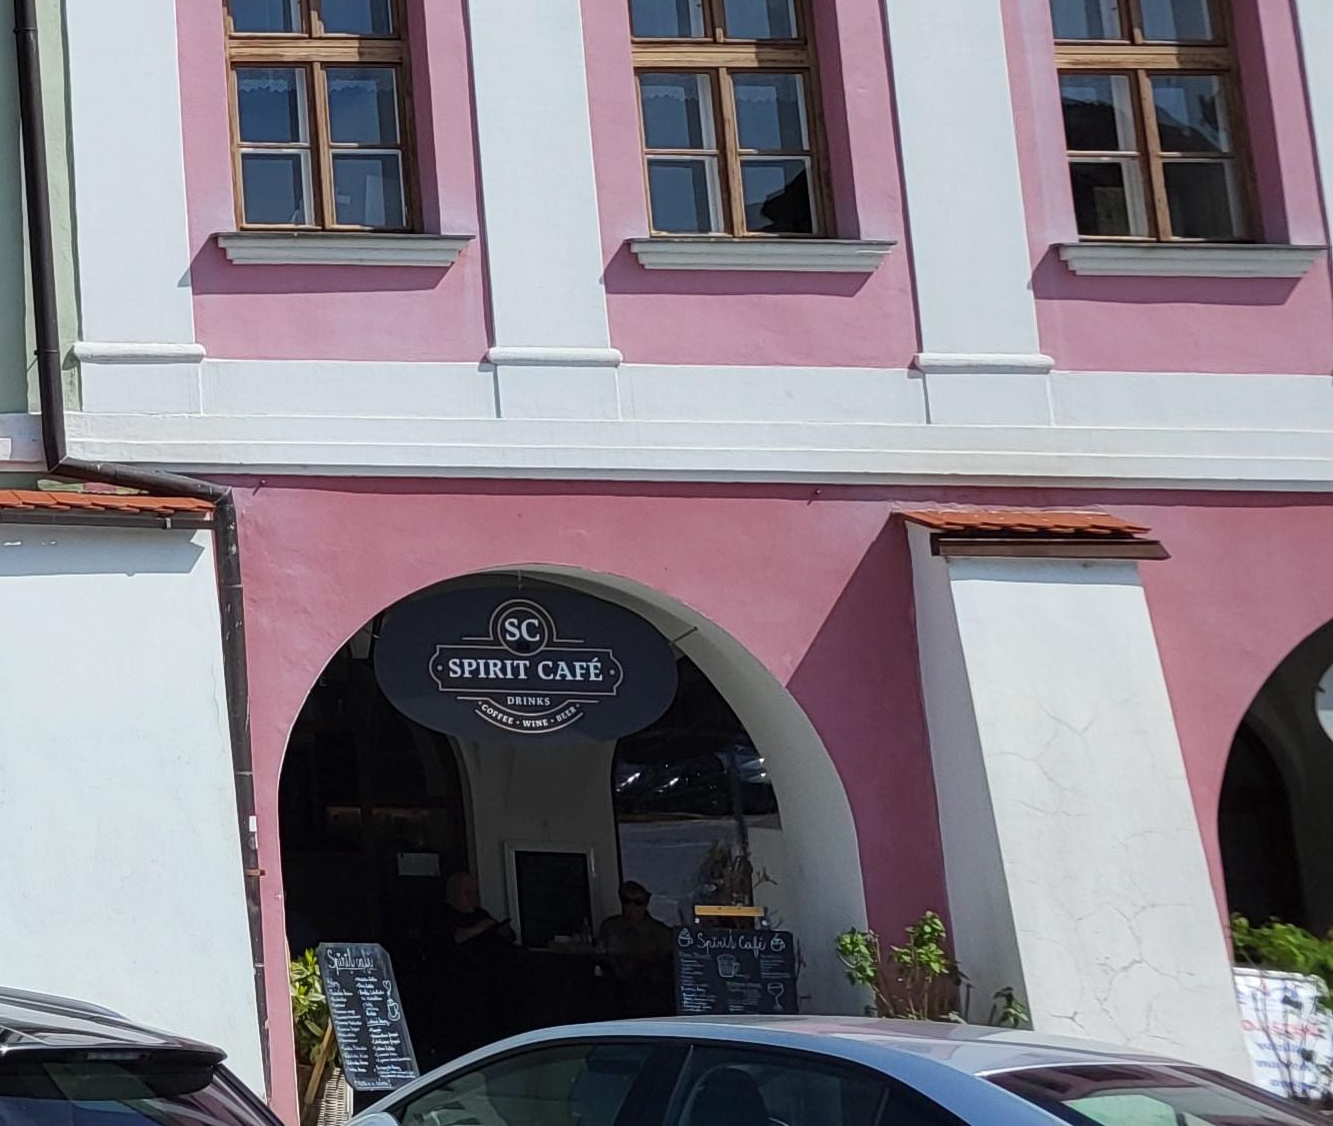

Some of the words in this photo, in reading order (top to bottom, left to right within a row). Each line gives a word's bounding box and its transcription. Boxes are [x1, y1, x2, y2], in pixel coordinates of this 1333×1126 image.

[504, 617, 541, 642] SC
[448, 658, 530, 680] SPIRIT
[536, 657, 604, 682] CAFÉ
[506, 695, 552, 707] DRINKS
[481, 703, 515, 725] COFFEE
[521, 718, 550, 728] WINE
[555, 705, 578, 723] BEER
